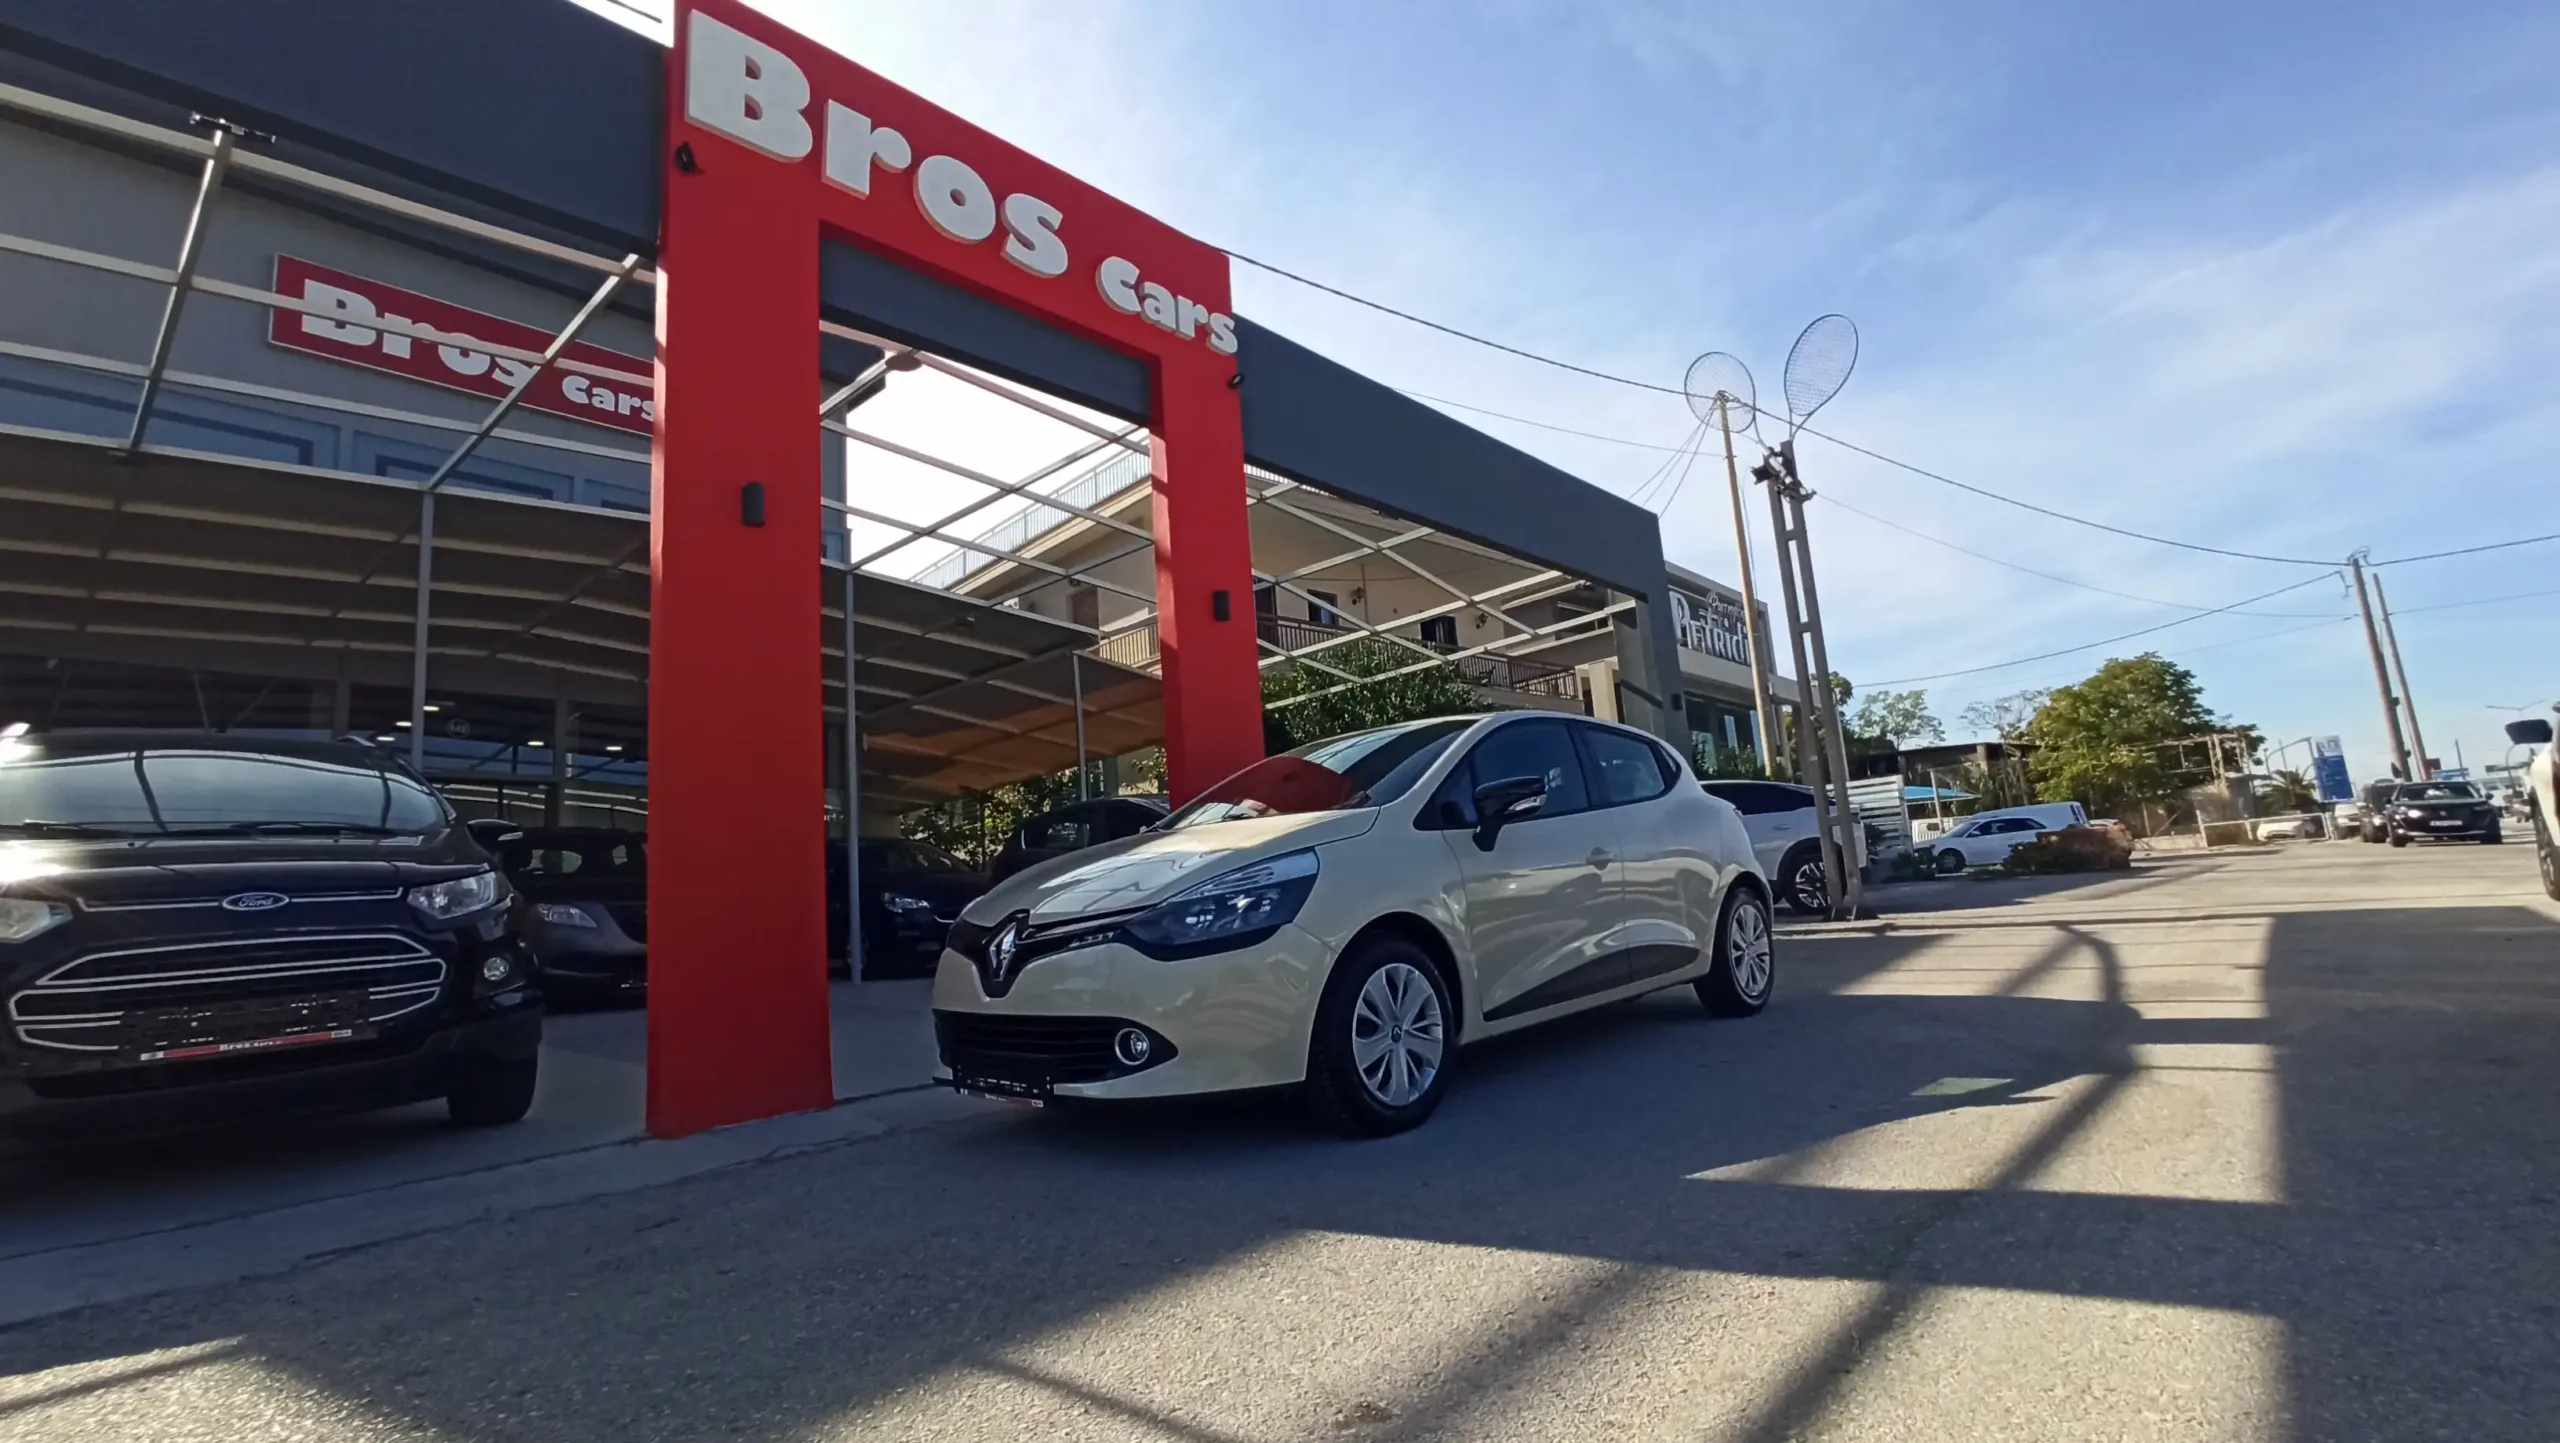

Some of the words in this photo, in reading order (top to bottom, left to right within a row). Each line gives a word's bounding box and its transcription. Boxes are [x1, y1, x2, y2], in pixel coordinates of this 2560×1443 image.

[684, 9, 1068, 278] Bros
[1096, 256, 1238, 355] Cars
[239, 895, 274, 907] Ford
